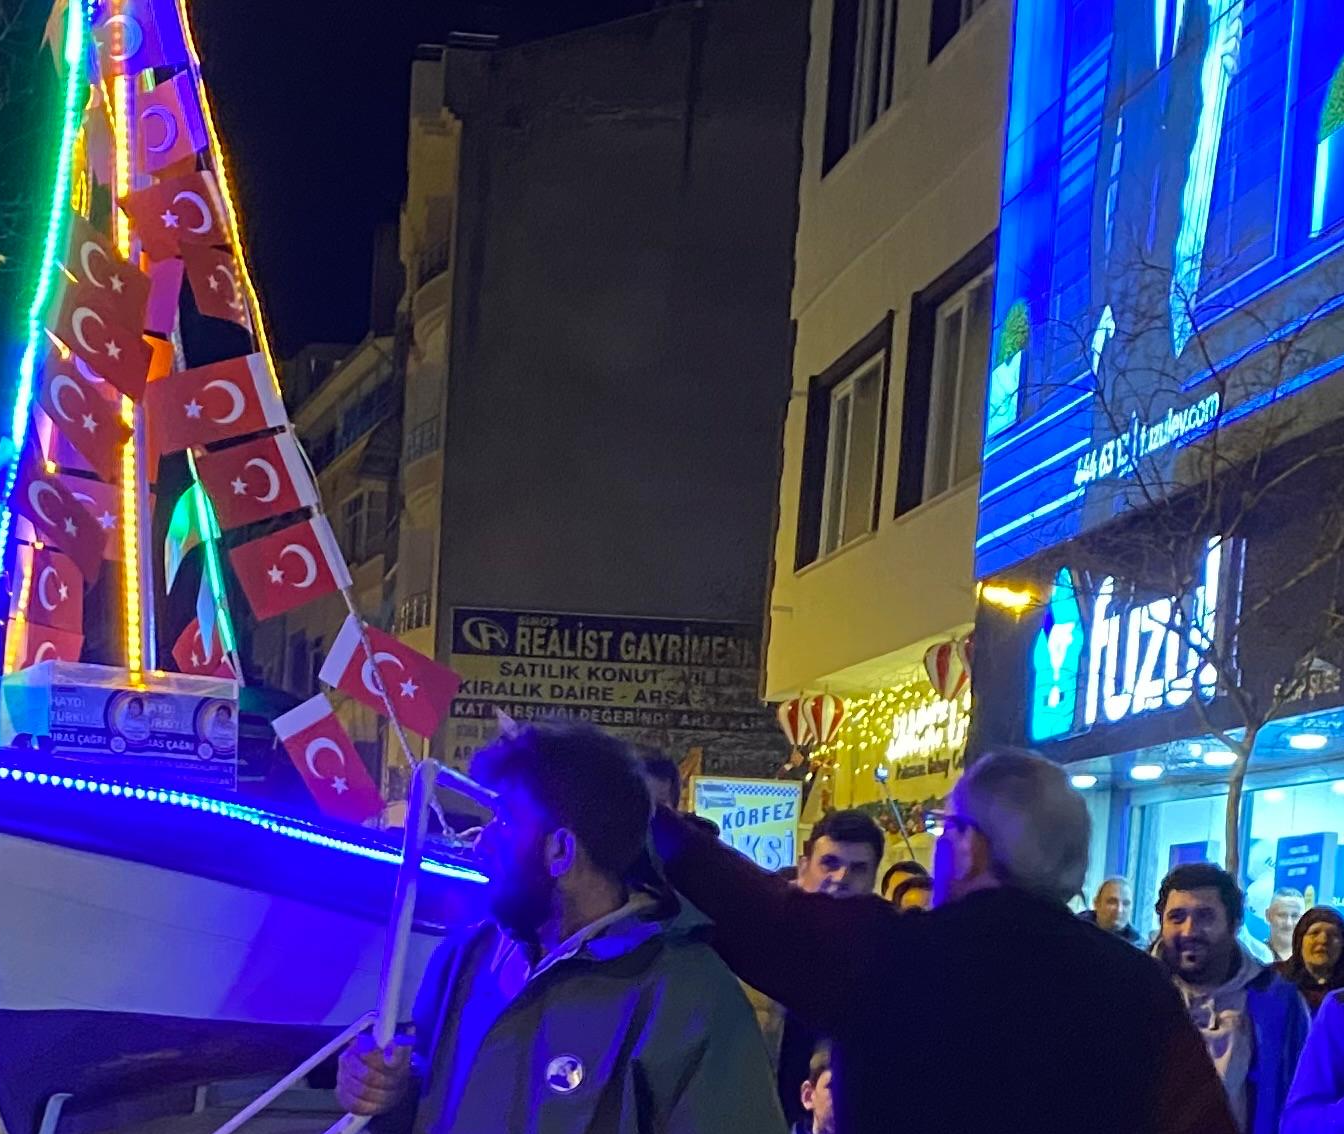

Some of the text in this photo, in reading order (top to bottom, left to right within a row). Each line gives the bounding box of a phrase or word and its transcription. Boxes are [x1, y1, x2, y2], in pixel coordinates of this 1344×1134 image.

[515, 621, 613, 657] REALİST
[499, 661, 580, 681] SATILIK
[586, 665, 657, 684] KONUT
[550, 682, 614, 701] DAİRE
[455, 702, 484, 716] KAT
[722, 800, 795, 830] KÖRFEZ
